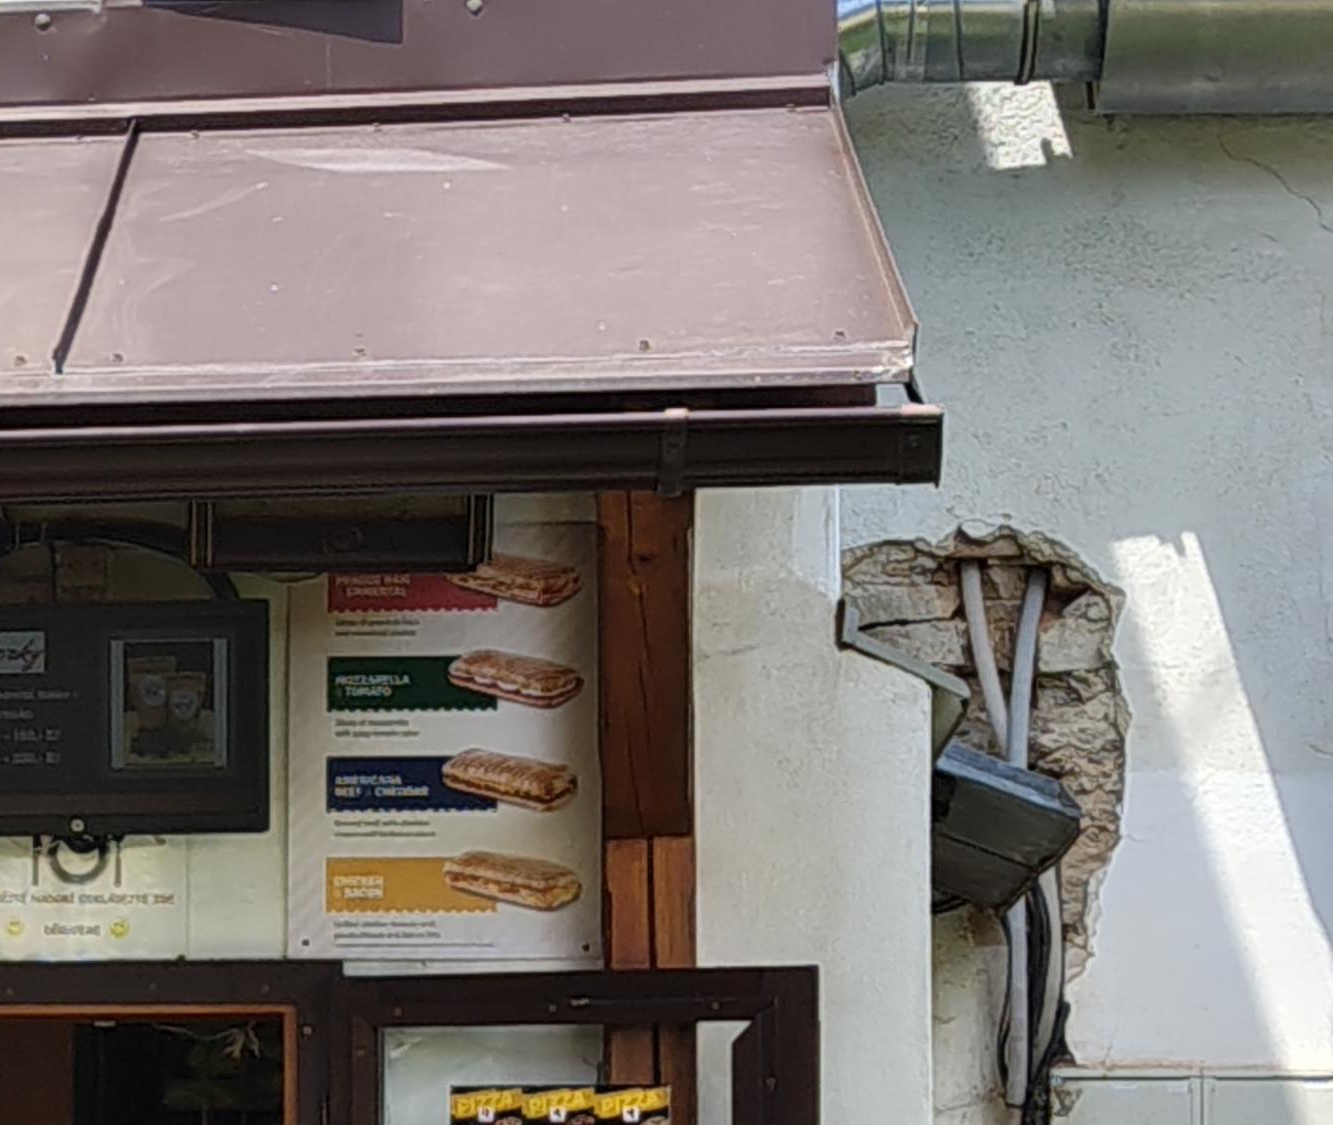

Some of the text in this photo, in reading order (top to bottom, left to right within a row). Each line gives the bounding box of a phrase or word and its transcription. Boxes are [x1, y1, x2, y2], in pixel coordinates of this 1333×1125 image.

[456, 1091, 514, 1113] PIZZA
[528, 1091, 588, 1113] PIZZA
[601, 1091, 660, 1112] PIZZA
